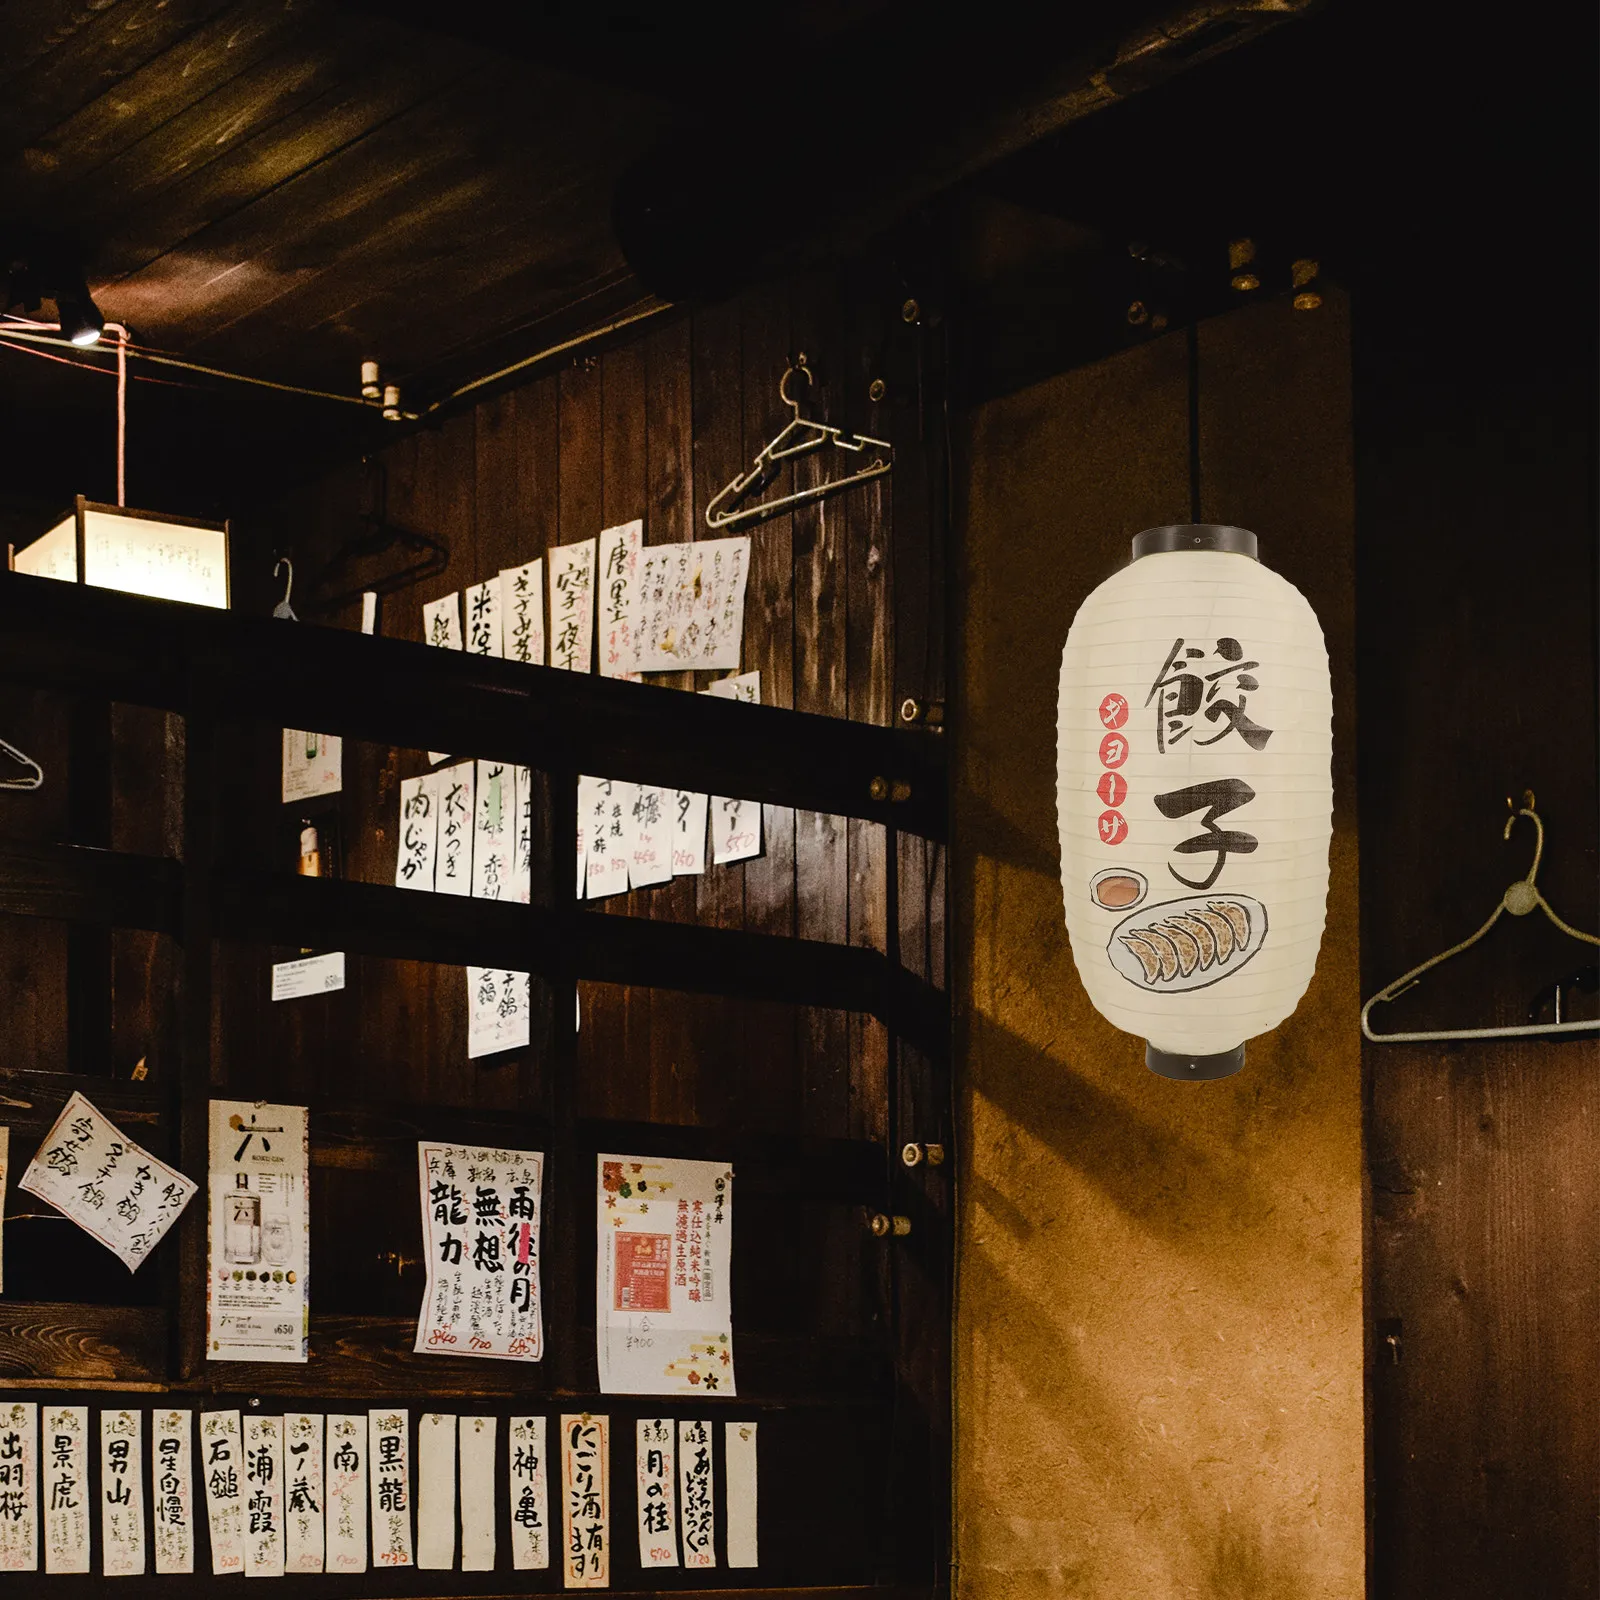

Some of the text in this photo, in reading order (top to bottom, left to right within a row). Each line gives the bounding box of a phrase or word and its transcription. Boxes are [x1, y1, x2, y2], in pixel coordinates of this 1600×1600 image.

[1144, 637, 1274, 890] 餃子
[401, 785, 430, 880] 肉じゃが
[445, 783, 466, 878] 衣かつぎ
[726, 832, 756, 853] 550
[47, 1117, 94, 1176] 寄せ鍋
[234, 1114, 284, 1162] 六
[429, 1179, 468, 1265] 龍力
[473, 1185, 505, 1273] 無想
[0, 1431, 28, 1521] 出羽桜
[51, 1434, 78, 1511] 景虎
[107, 1440, 131, 1506] 男山
[157, 1438, 185, 1526] 星自慢
[248, 1444, 276, 1534] 浦霞
[288, 1442, 319, 1513] 一ノ蔵
[333, 1441, 359, 1473] 南
[379, 1436, 406, 1512] 黒龍
[512, 1444, 542, 1528] 神亀
[571, 1424, 600, 1519] にごり酒
[643, 1449, 669, 1535] 月の桂
[381, 1553, 408, 1565] 730
[587, 1523, 603, 1573] 有り
[650, 1548, 671, 1561] 570
